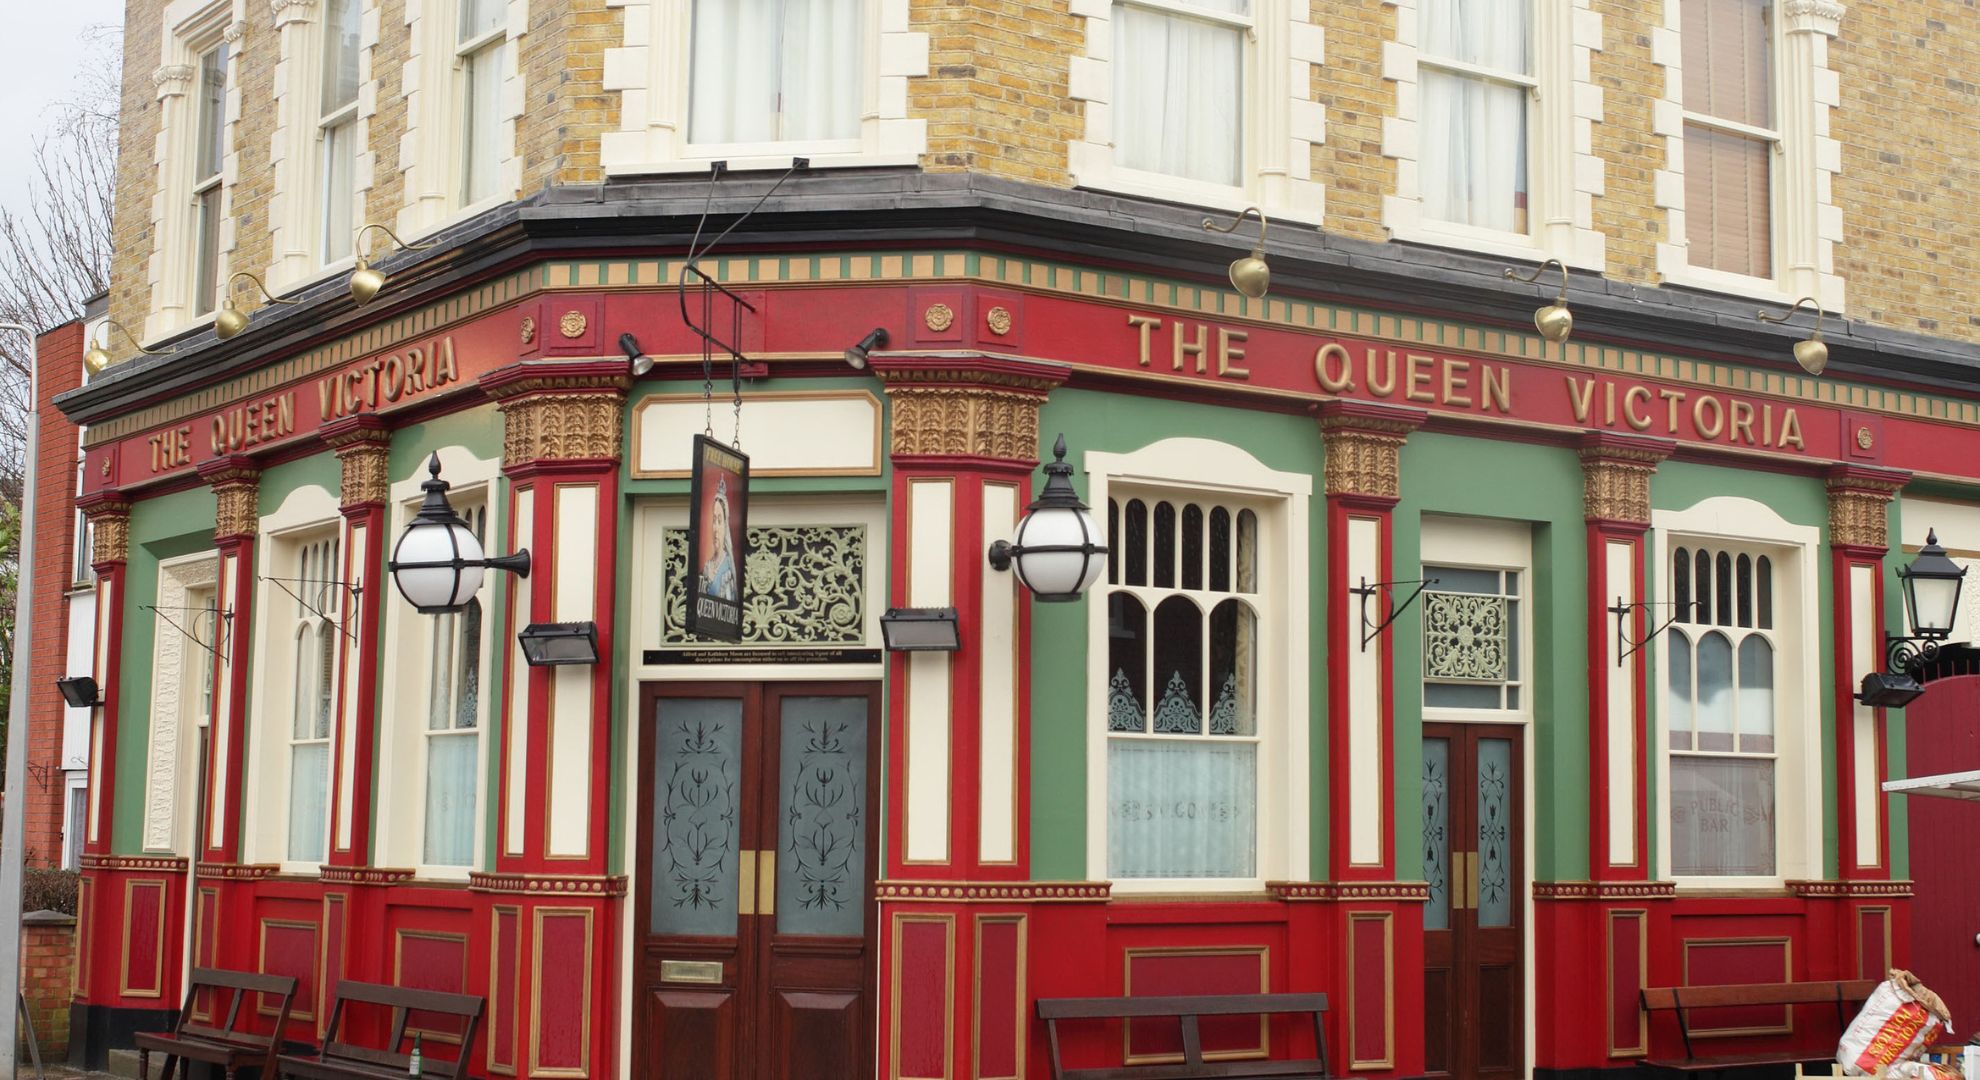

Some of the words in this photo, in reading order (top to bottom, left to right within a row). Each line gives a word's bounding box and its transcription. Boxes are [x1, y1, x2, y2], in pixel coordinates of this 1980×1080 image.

[1128, 314, 1251, 379] THE
[1314, 342, 1512, 413] QUEEN
[1565, 376, 1805, 451] VICTORIA
[148, 425, 192, 473] THE
[210, 392, 294, 457] QUEEN
[318, 336, 459, 421] VICTORIA
[697, 597, 716, 619] QUEEN
[1691, 798, 1739, 817] PUBLIC
[1700, 818, 1730, 833] BAR
[1868, 1007, 1912, 1057] POTATOES
